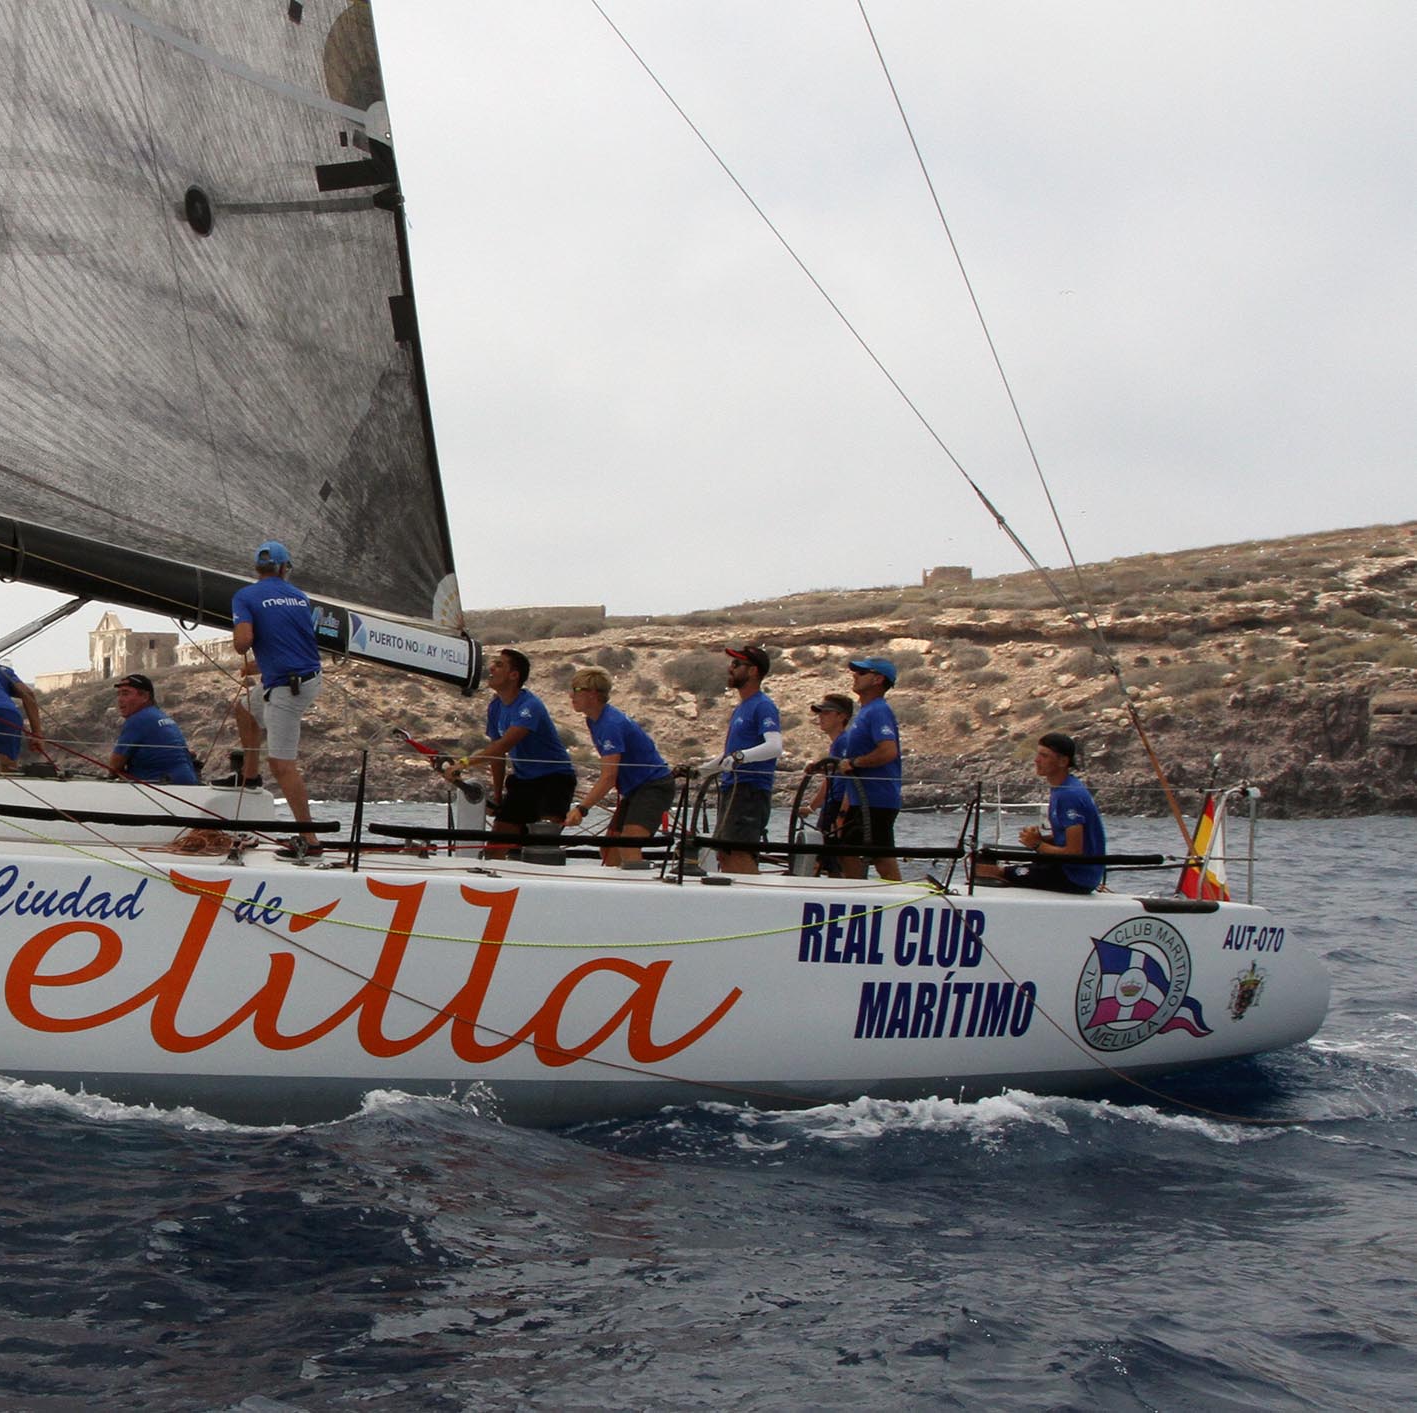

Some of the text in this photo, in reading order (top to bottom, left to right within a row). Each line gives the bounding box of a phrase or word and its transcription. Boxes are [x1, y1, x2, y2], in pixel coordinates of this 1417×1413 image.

[262, 597, 307, 608] melilla
[369, 630, 403, 649] PUERTO
[234, 881, 284, 924] de
[798, 902, 986, 968] REAL CLUB
[1223, 924, 1285, 952] AUT-070
[854, 971, 1037, 1038] MARÍTIMO
[1081, 922, 1187, 1047] REAL CLUB MARITIMO MELILLA
